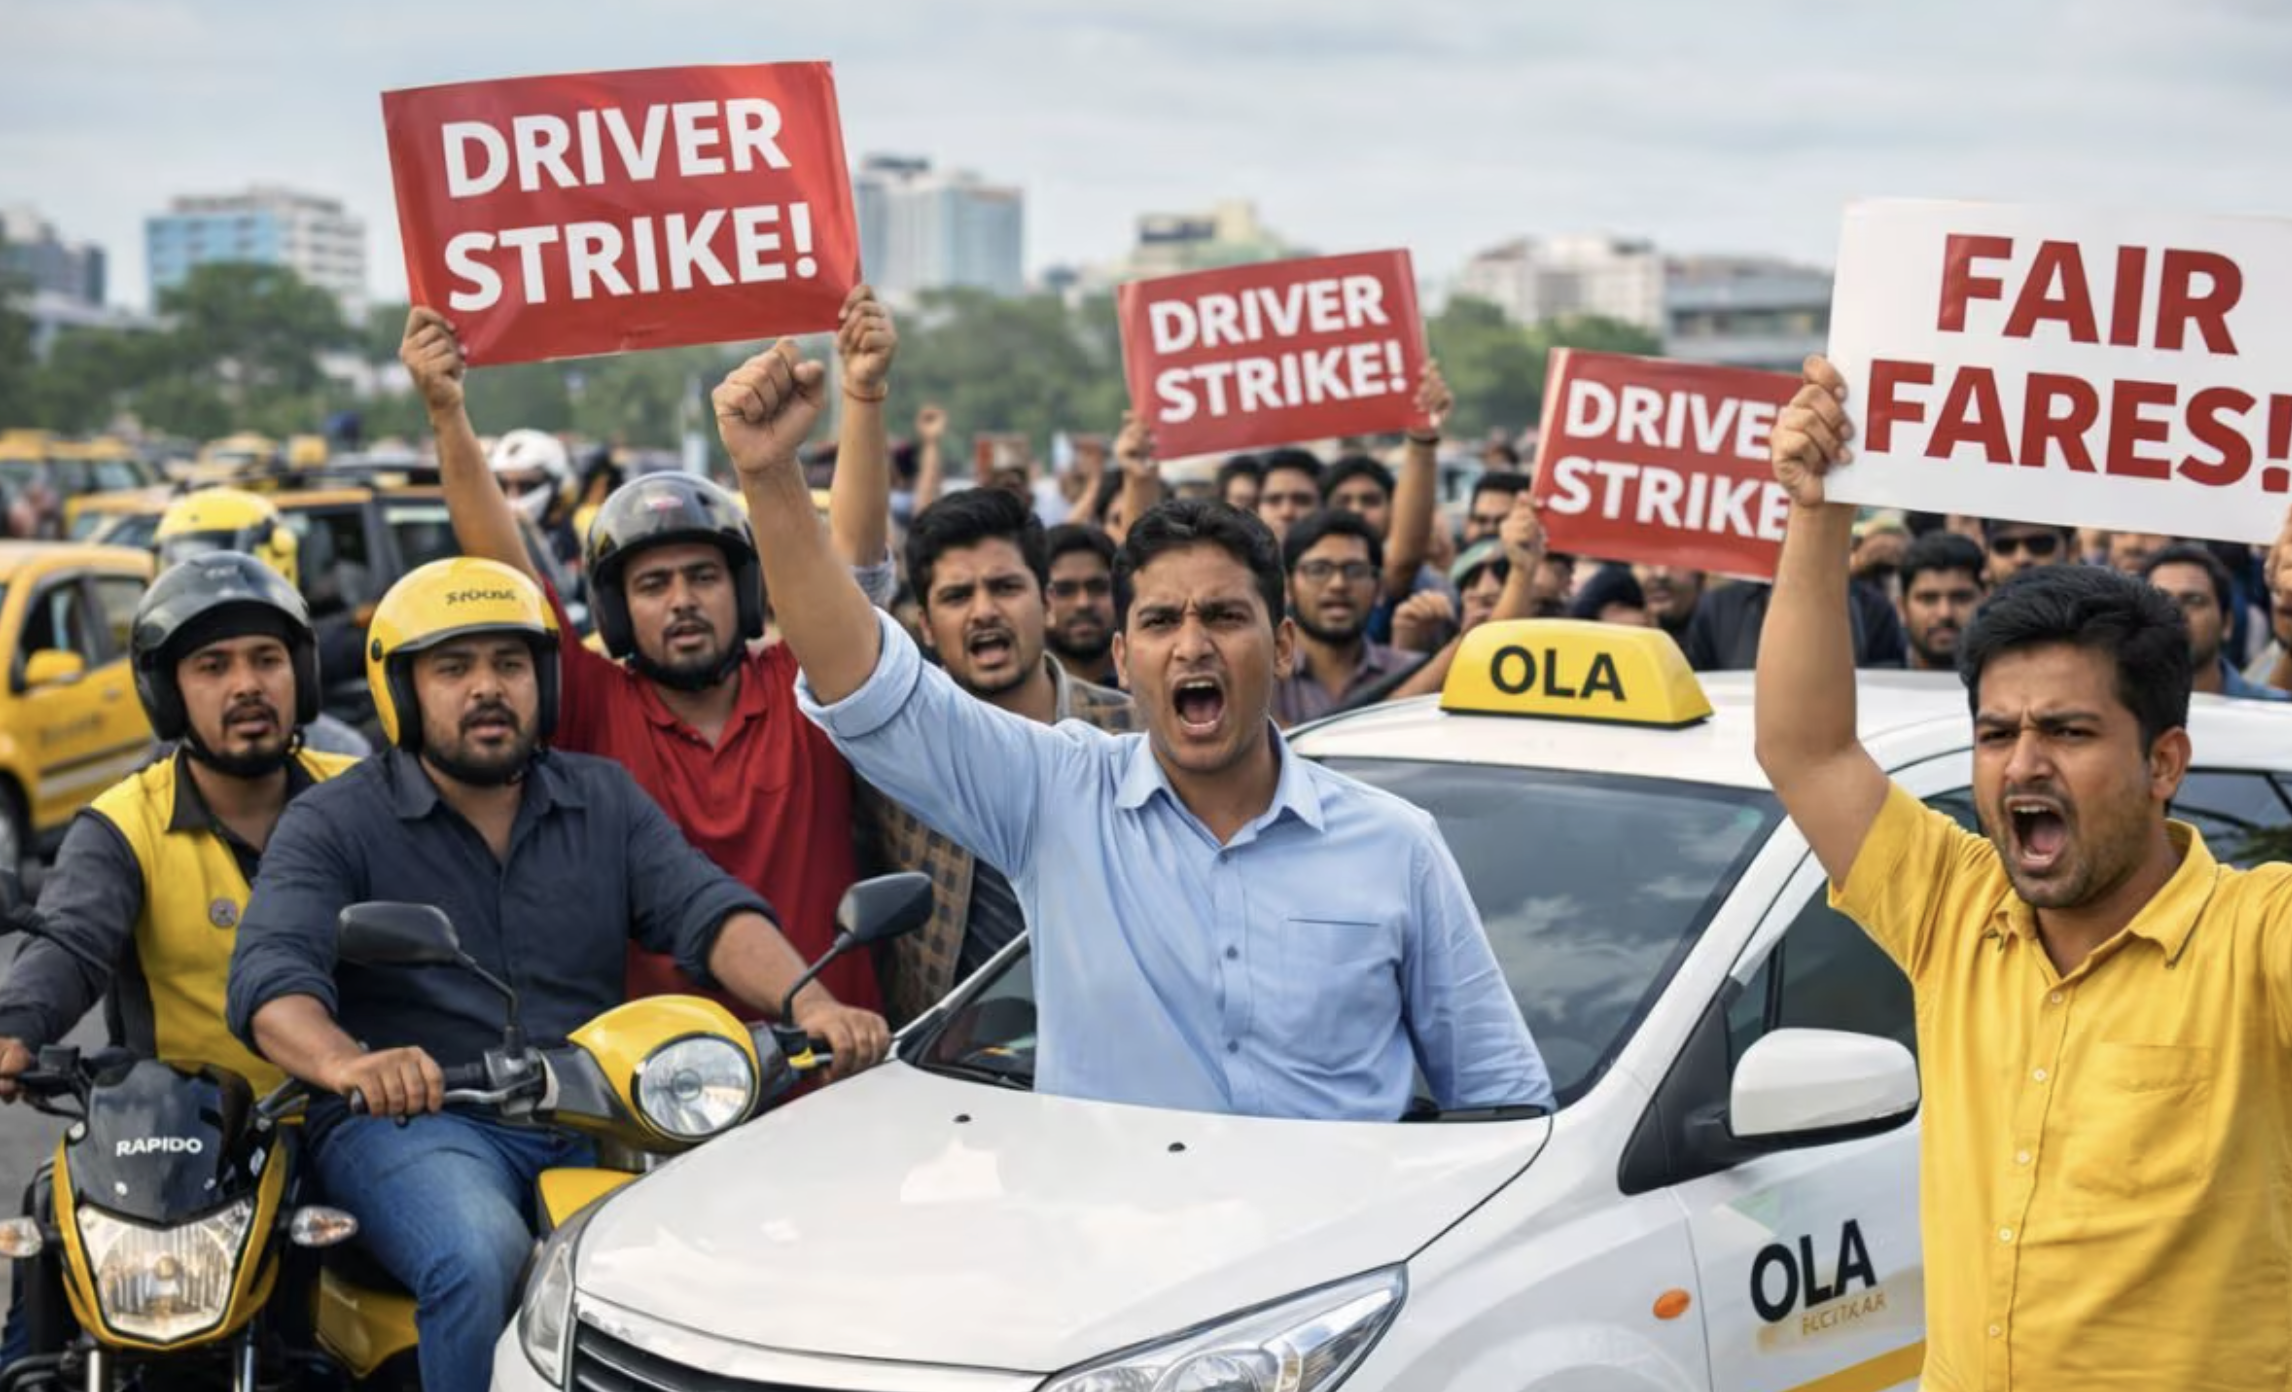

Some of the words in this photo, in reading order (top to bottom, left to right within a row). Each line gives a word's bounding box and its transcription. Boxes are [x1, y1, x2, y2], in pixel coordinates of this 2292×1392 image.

[441, 98, 791, 198] DRIVER
[444, 202, 818, 312] STRIKE!
[1937, 233, 2243, 355] FAIR
[1149, 275, 1390, 354] DRIVER
[1155, 340, 1408, 423] STRIKE!
[1564, 379, 1778, 461] DRIVE
[1865, 359, 2292, 493] FARES!
[1548, 456, 1790, 542] STRIKE
[1490, 644, 1627, 702] OLA
[116, 1136, 203, 1157] RAPIDO
[1750, 1218, 1877, 1323] OLA
